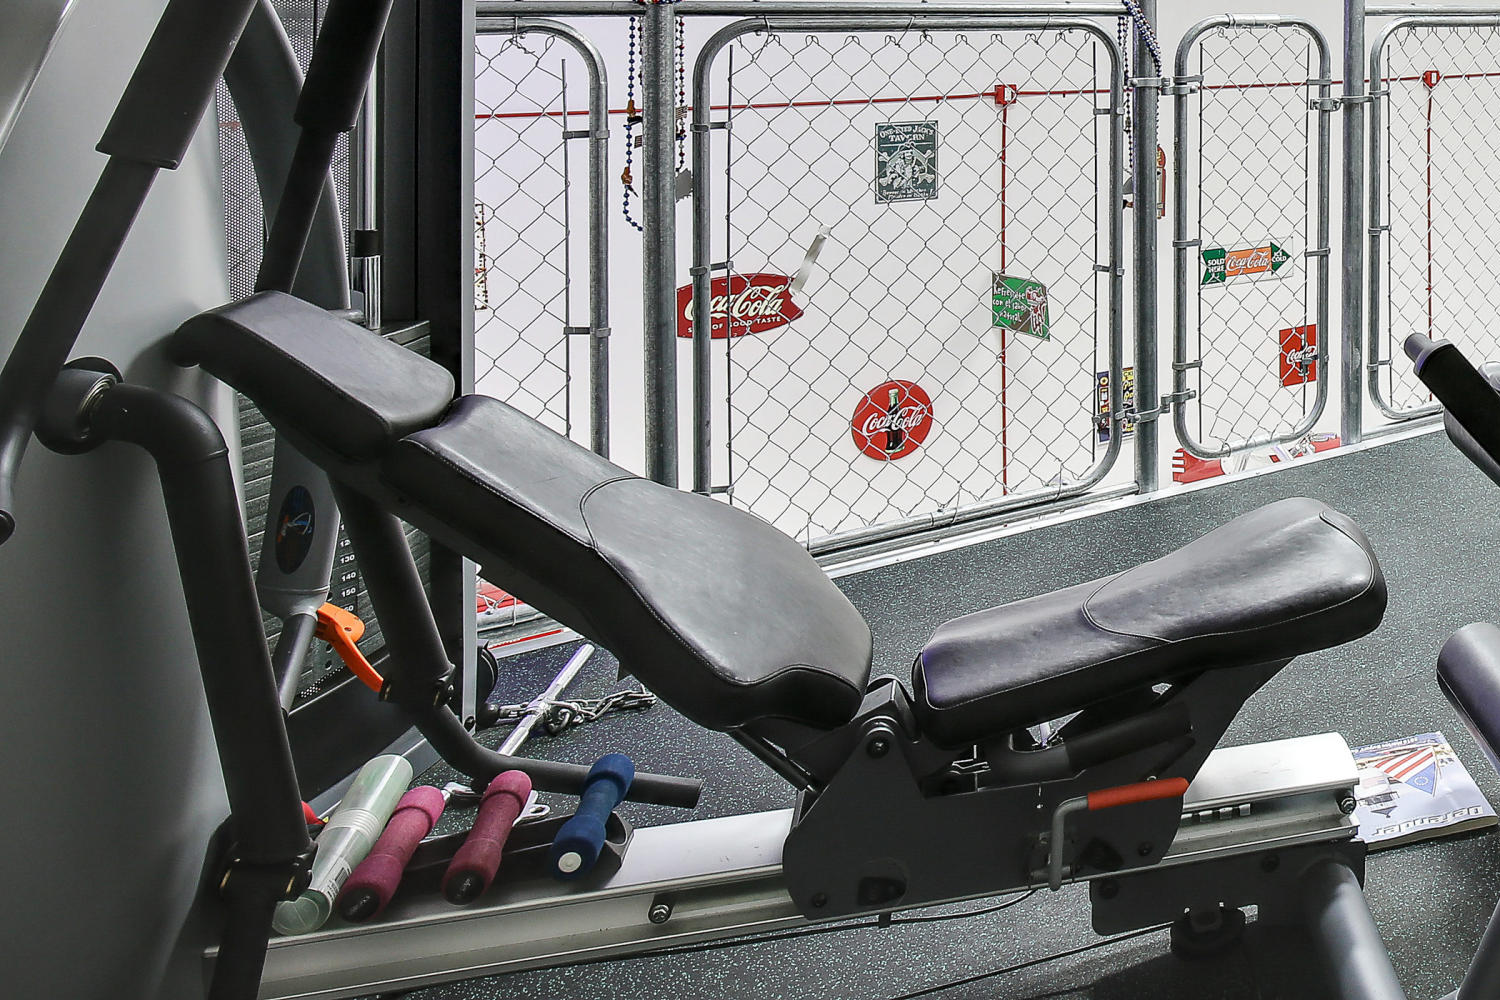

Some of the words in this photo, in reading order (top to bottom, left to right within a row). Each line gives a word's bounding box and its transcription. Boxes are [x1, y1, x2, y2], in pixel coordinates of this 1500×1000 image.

[1207, 259, 1226, 267] SOLD
[1226, 250, 1270, 271] Coca-Cola
[684, 285, 784, 320] Cca-Cola
[757, 316, 781, 325] TASTE
[862, 404, 924, 435] Coca-Cola
[340, 554, 355, 563] 130
[341, 571, 357, 582] 140
[341, 587, 356, 598] 150
[1372, 806, 1484, 836] Defender
